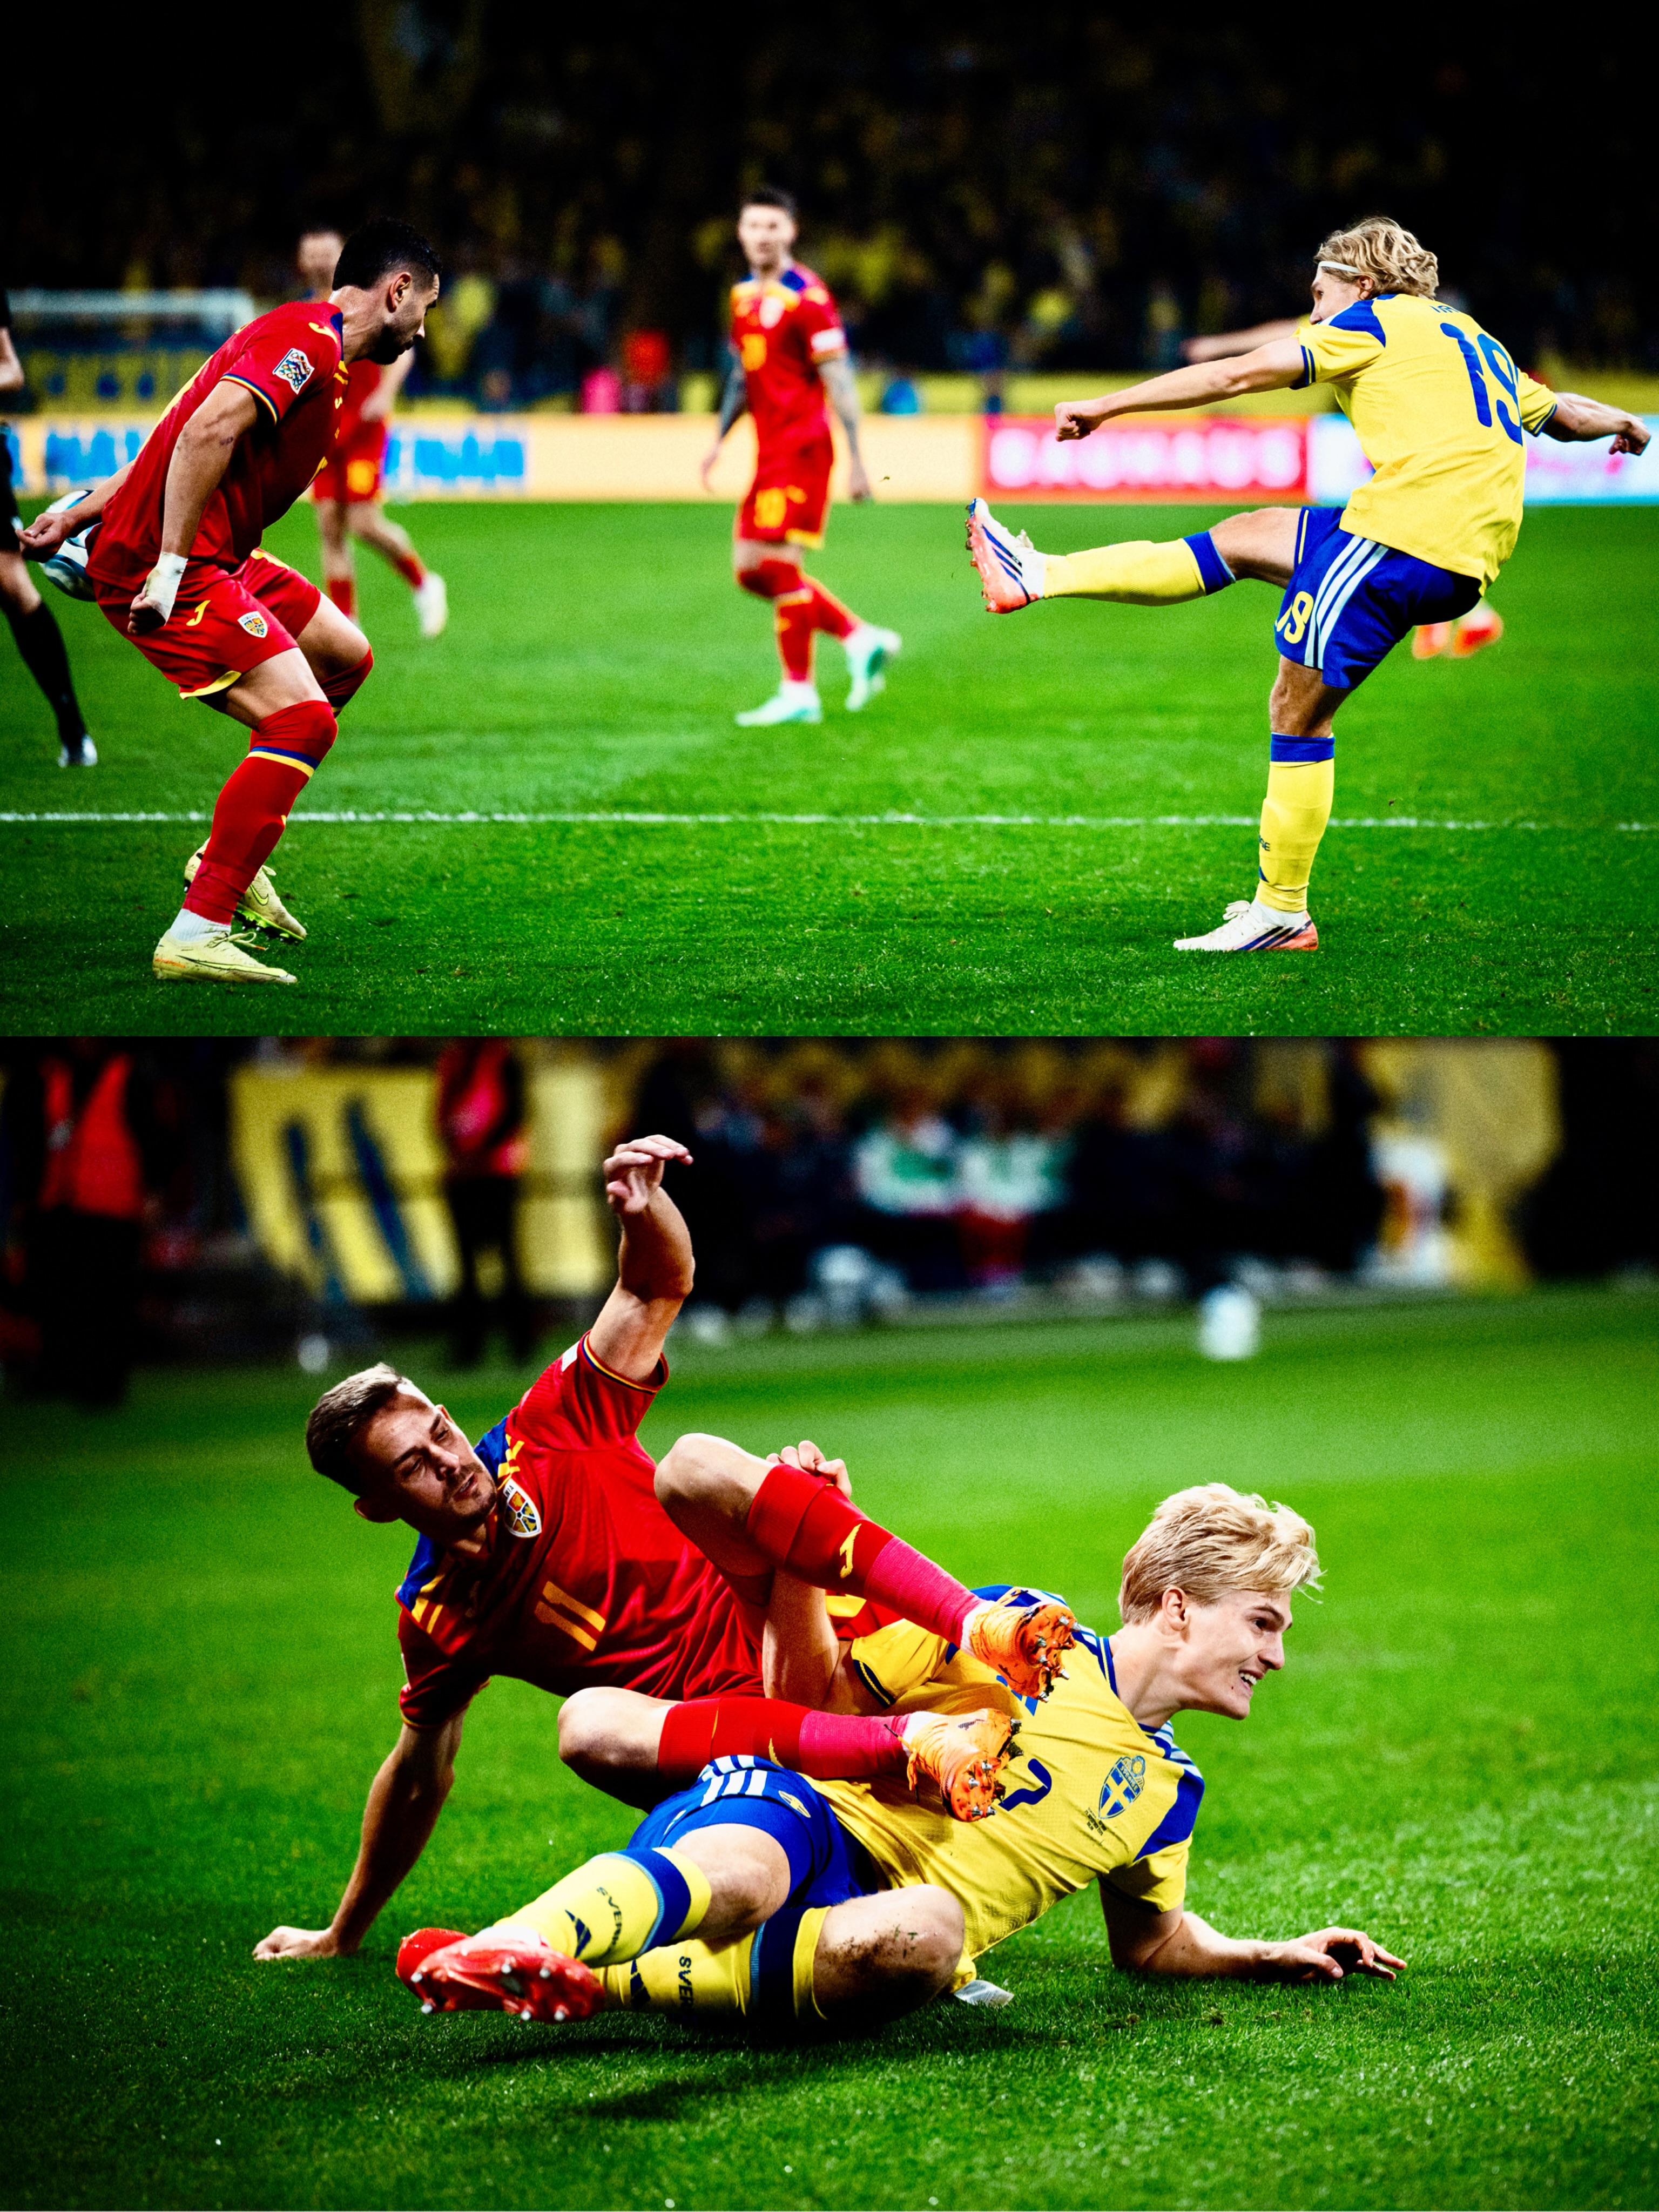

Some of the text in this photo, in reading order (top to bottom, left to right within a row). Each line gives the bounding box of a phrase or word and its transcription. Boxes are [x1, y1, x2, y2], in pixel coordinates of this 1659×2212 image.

[1440, 322, 1523, 446] 19
[534, 1581, 606, 1651] 11
[1120, 1765, 1137, 1791] SVERIGE
[679, 1955, 694, 2008] SVER
